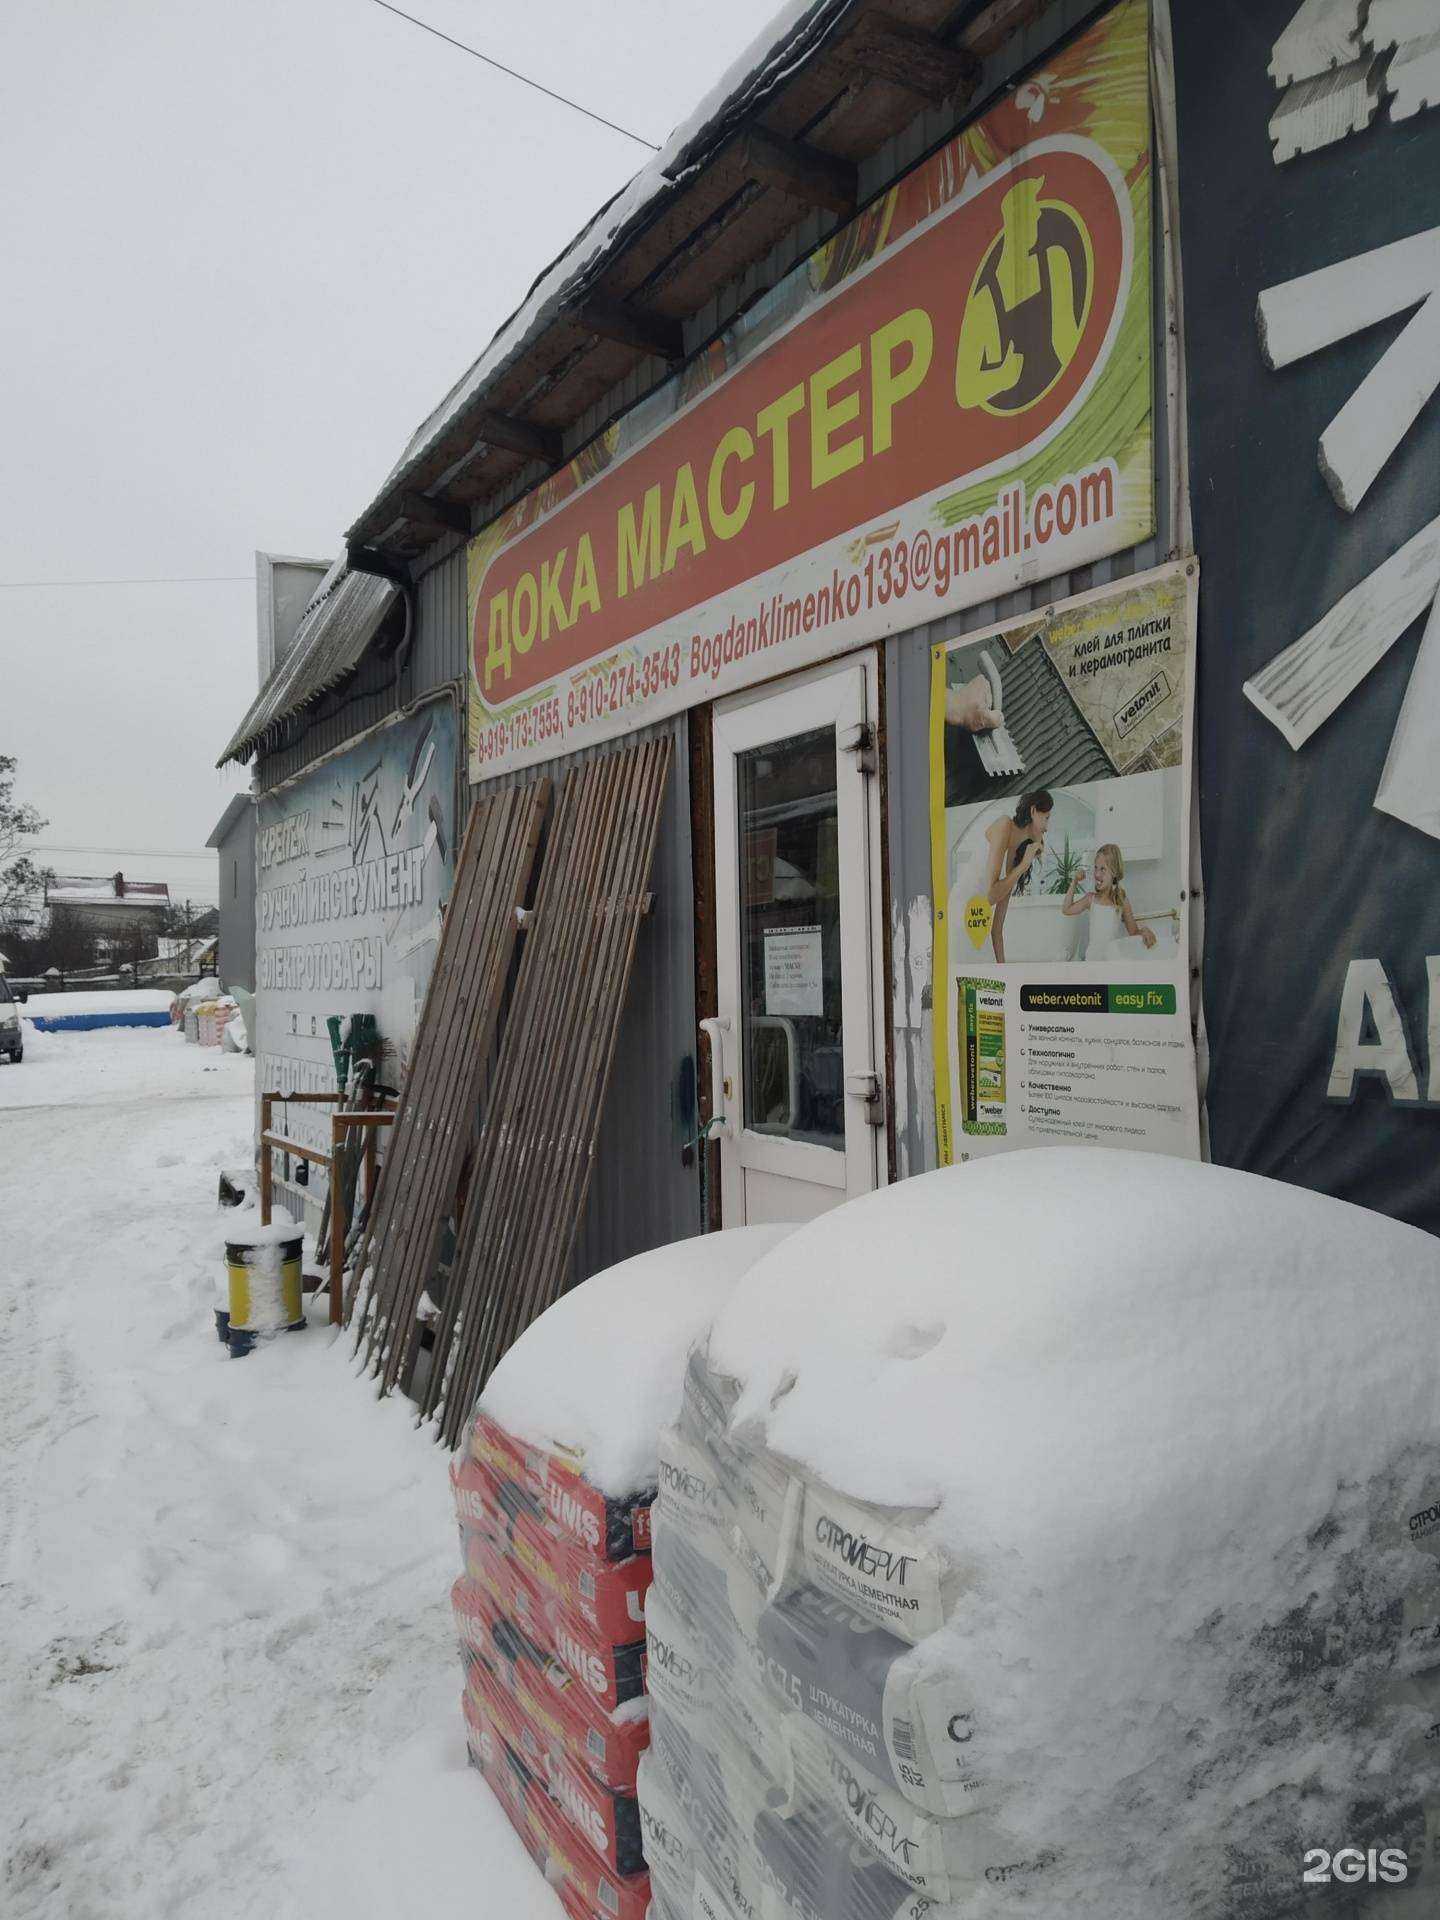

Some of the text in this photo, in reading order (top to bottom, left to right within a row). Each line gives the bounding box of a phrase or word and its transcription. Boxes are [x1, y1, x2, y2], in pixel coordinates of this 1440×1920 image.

[484, 308, 934, 690] ДОКА МАСТЕР
[567, 642, 681, 728] 8-910-274-3543
[689, 466, 1115, 679] Bogdanklimenko133@gmail.com
[1068, 637, 1171, 678] и керамогранита
[1074, 616, 1171, 658] клей для плитки
[1120, 681, 1161, 724] vetonit
[262, 844, 425, 932] РУЧНОЙ ИНСТРУМЕНТ
[970, 907, 984, 917] we
[261, 936, 384, 992] ЭЛЕКТРОТОВАРЫ
[1028, 991, 1164, 1007] weber.vetonit easy fix
[815, 1515, 918, 1586] СТРОЙБРИГ
[857, 1582, 920, 1611] ЦЕМЕНТНАЯ
[809, 1683, 880, 1738] ШТУКАТУРКА
